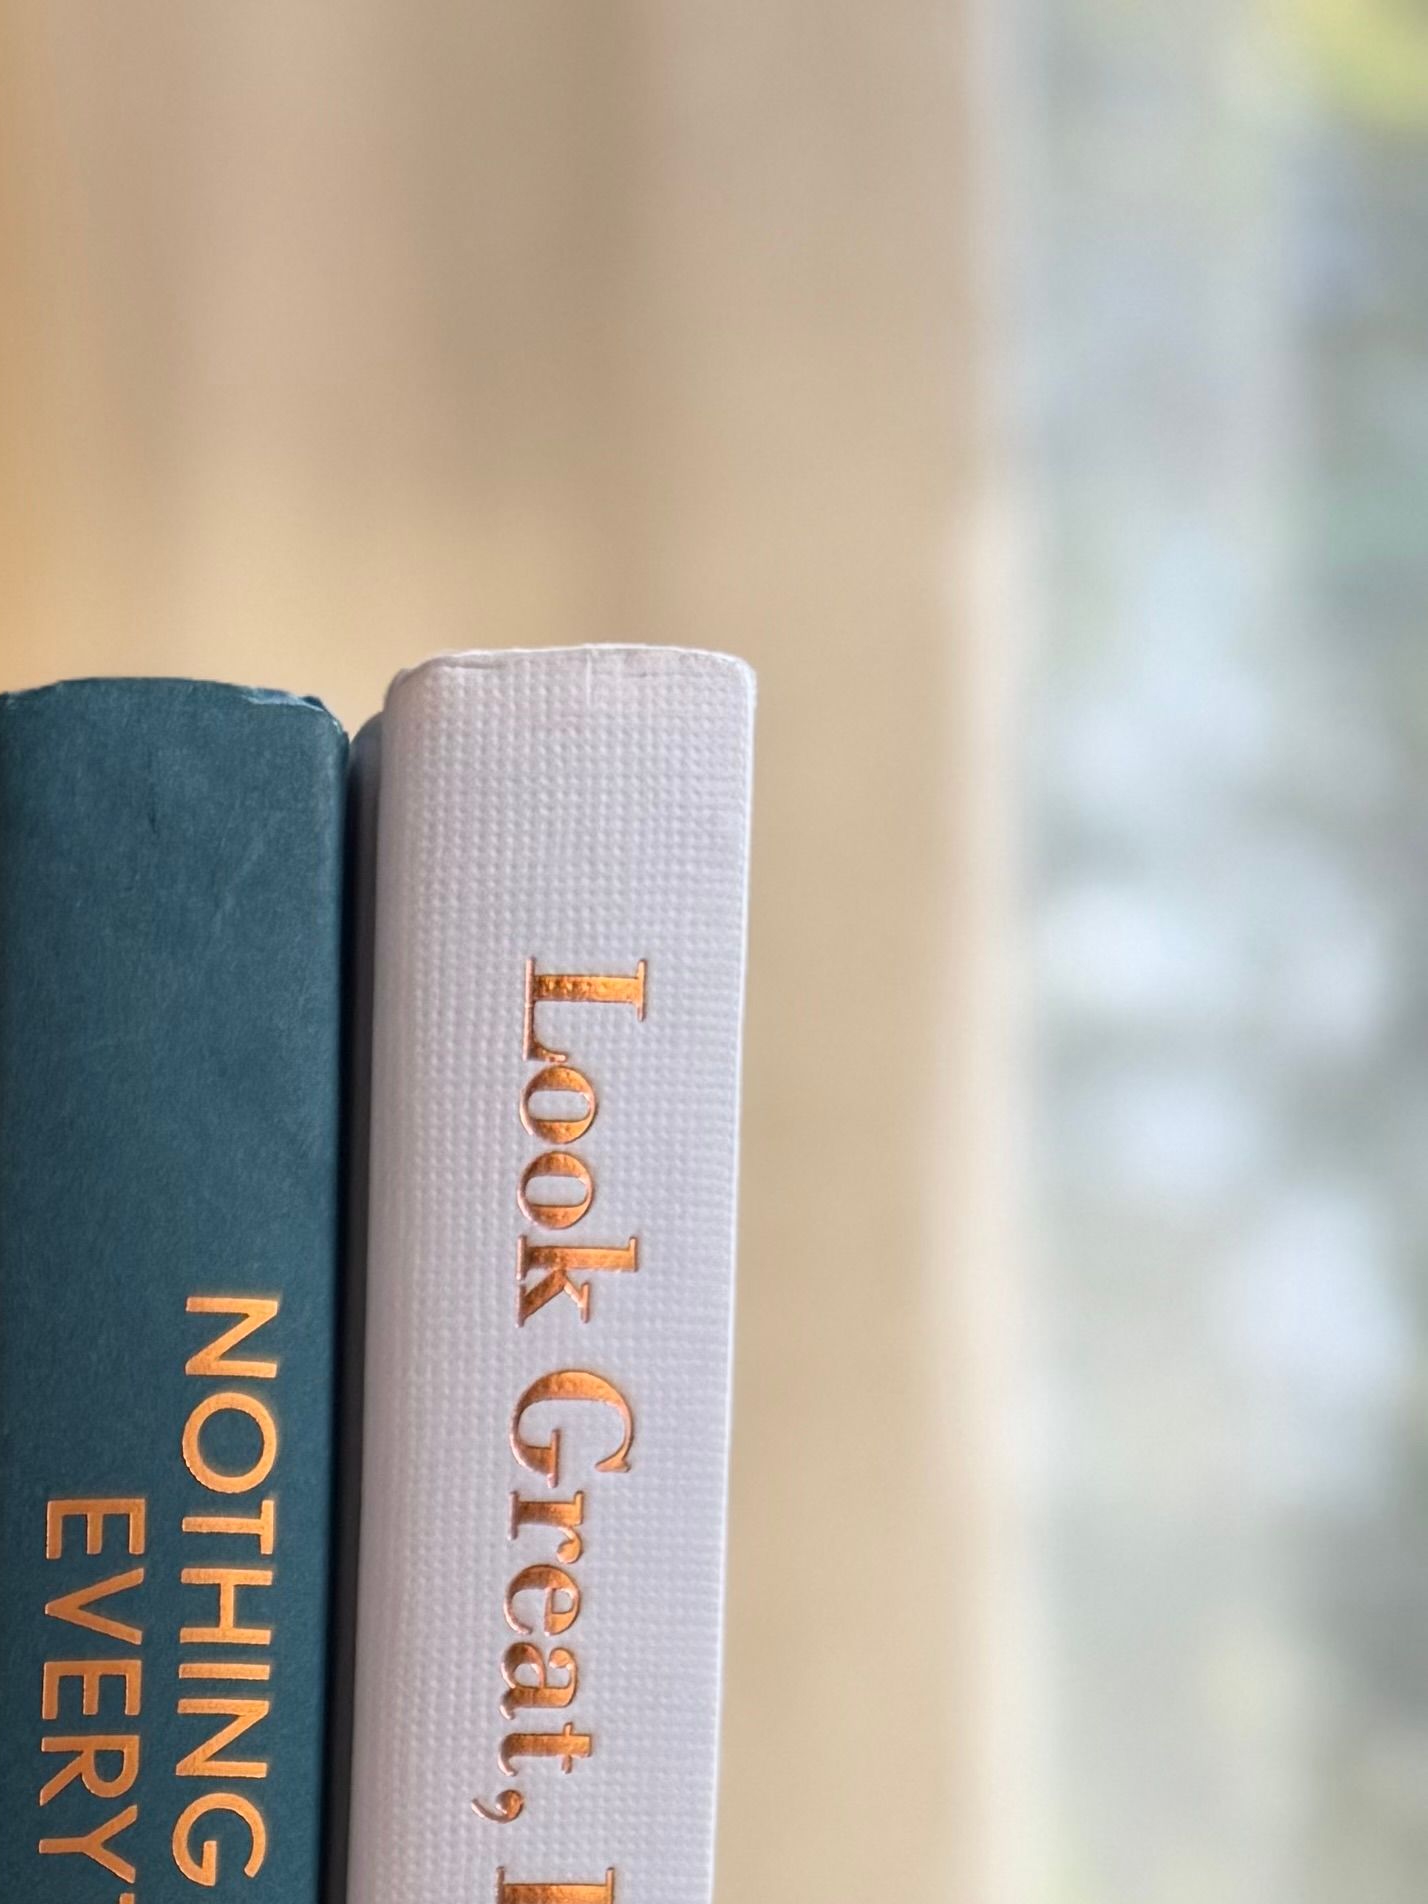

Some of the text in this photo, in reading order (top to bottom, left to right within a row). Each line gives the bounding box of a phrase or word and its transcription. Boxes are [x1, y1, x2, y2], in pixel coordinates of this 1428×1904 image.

[517, 955, 649, 1328] Look
[171, 1294, 281, 1887] NOTHING
[471, 1367, 637, 1825] Great,
